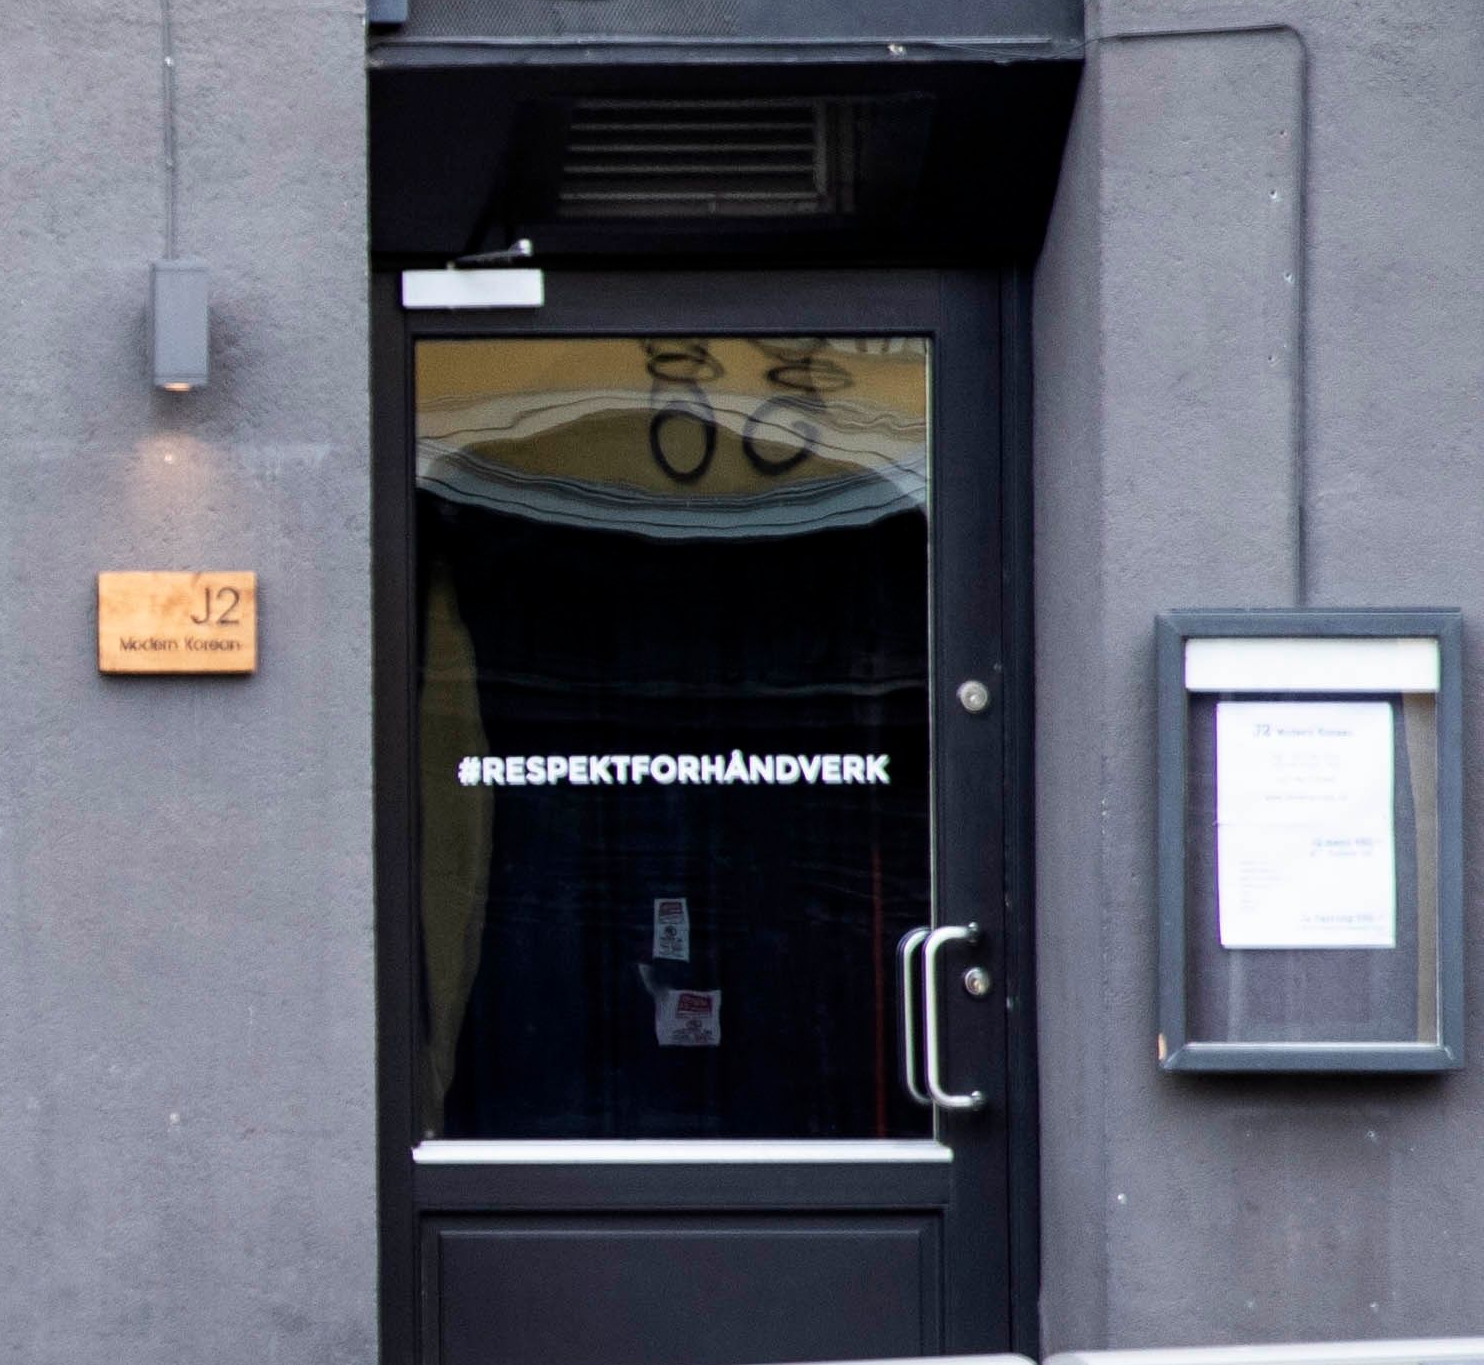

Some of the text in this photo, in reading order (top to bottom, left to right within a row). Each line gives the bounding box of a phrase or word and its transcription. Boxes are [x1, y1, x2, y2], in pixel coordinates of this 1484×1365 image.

[190, 587, 240, 625] J2
[120, 637, 242, 652] Modern Korean
[458, 749, 889, 785] #RESPEKTFORHÅNDVERK
